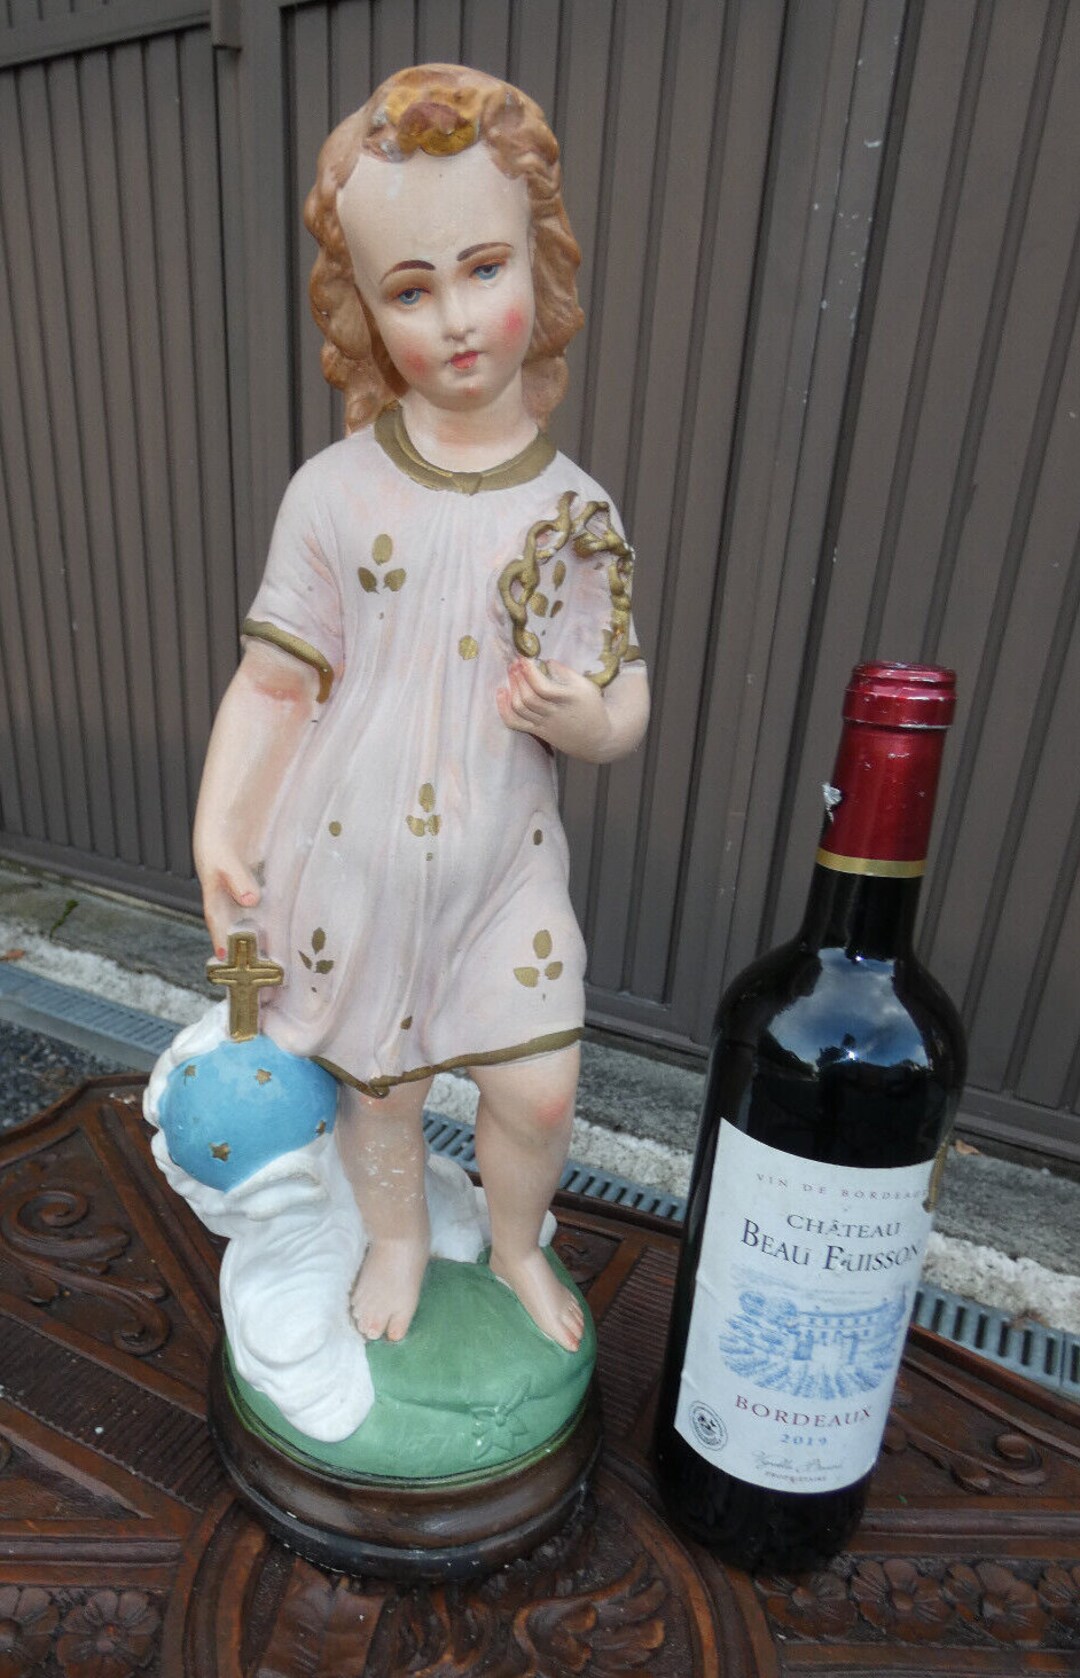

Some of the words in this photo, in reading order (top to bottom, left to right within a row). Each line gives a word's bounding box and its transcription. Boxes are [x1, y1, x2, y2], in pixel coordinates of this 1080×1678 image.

[756, 1173, 788, 1187] VIN
[802, 1183, 827, 1194] DE
[786, 1214, 902, 1238] CHÂTEAU
[741, 1217, 812, 1266] BEAU
[735, 1394, 872, 1428] BORDEAUX
[780, 1433, 828, 1446] 2019
